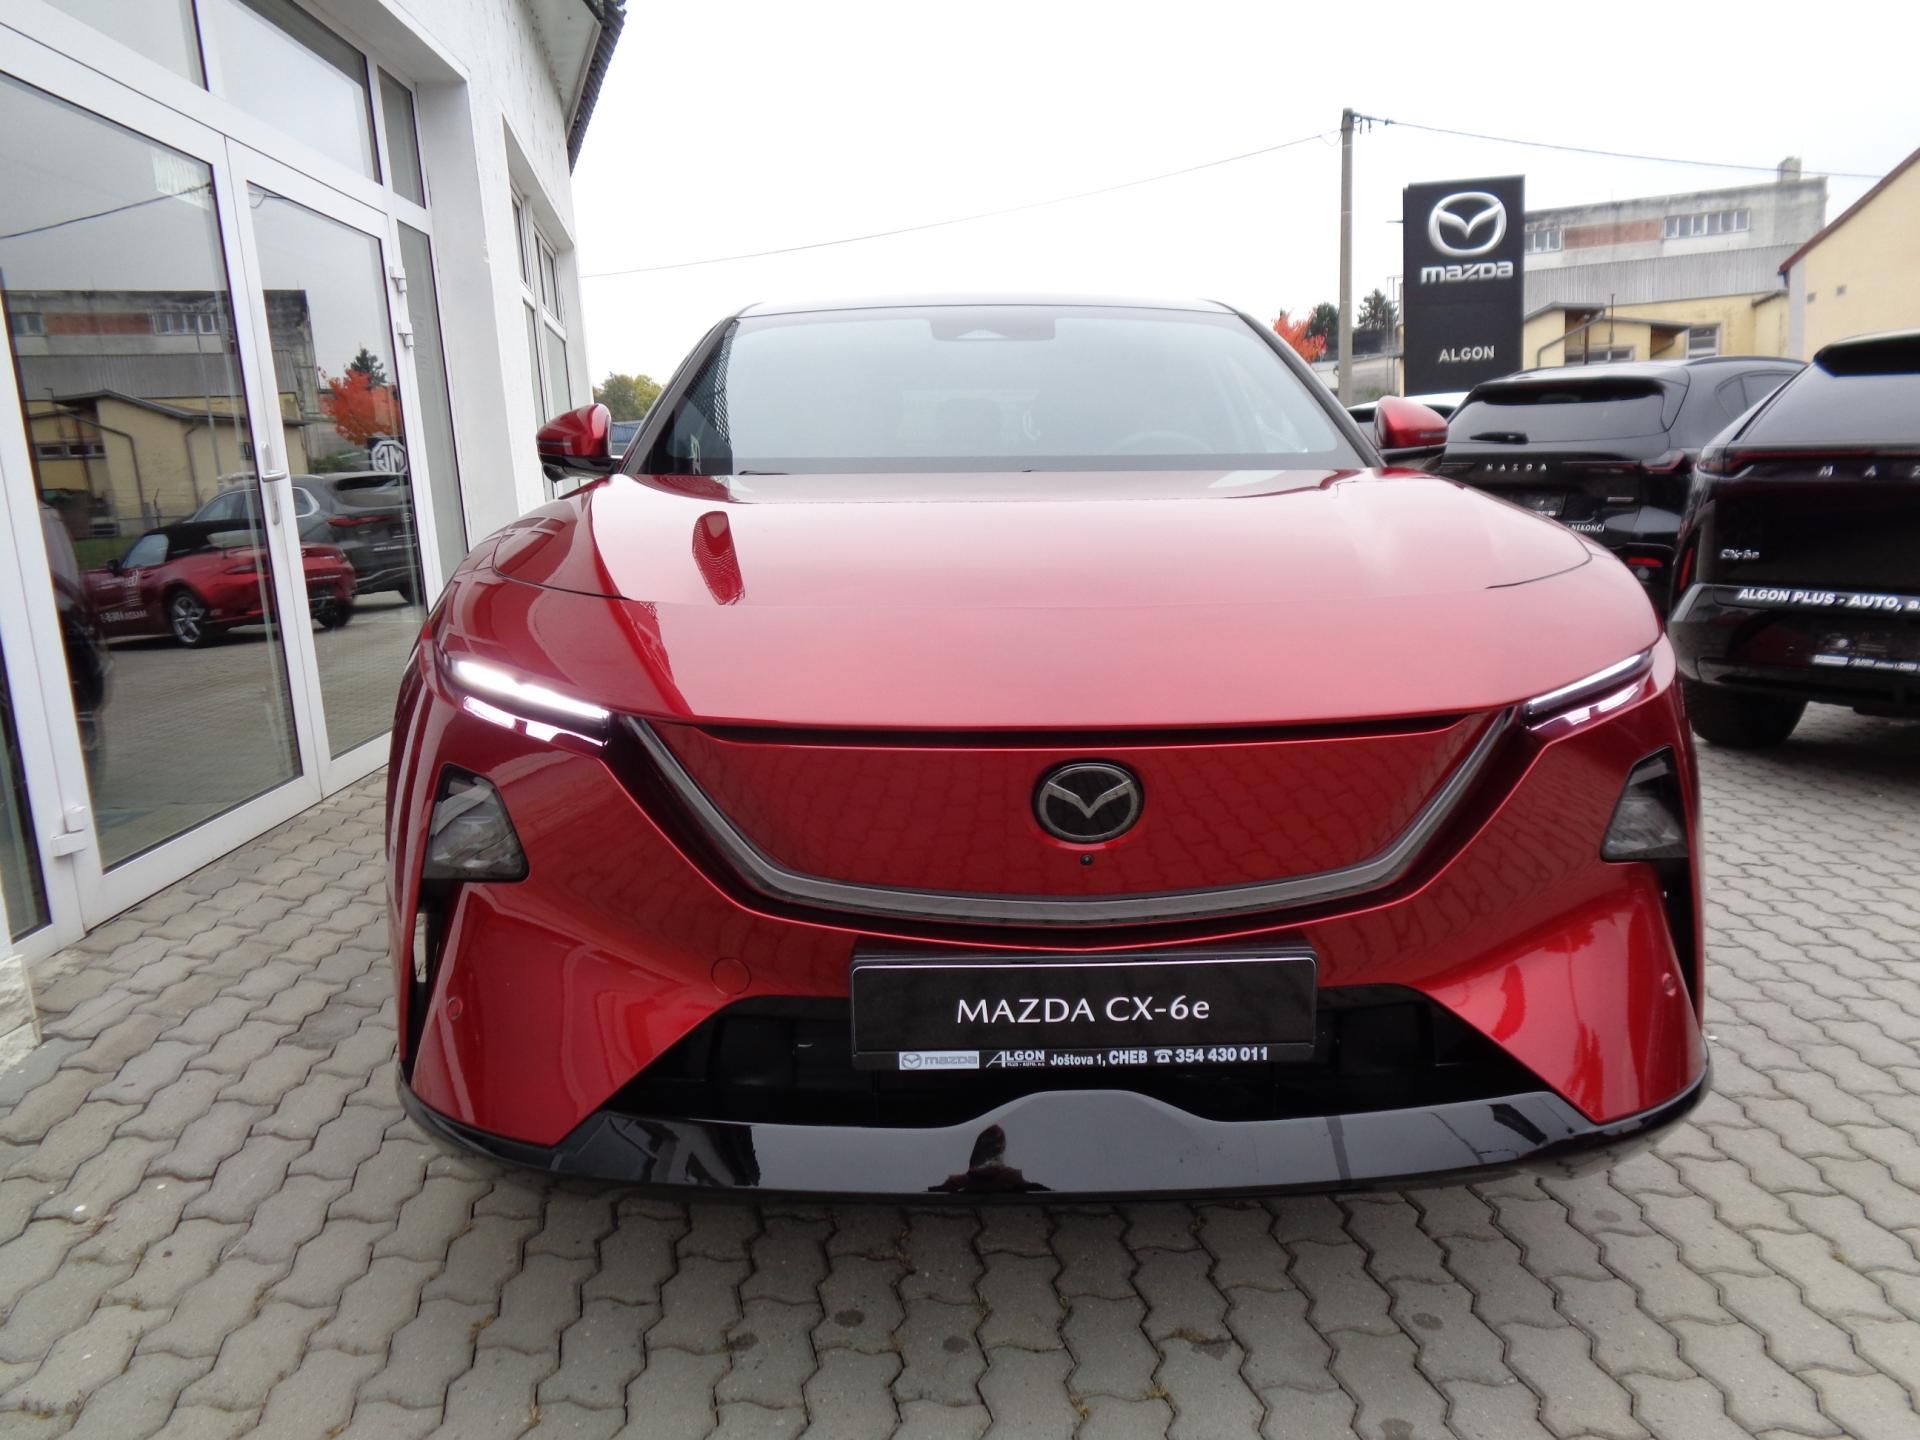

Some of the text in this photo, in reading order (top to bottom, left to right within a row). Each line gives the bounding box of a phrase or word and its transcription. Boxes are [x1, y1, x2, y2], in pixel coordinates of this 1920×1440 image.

[1421, 261, 1514, 283] mazda
[1439, 346, 1495, 362] ALGON
[1738, 588, 1790, 601] ALGON
[1793, 591, 1835, 604] PLUS
[1848, 594, 1902, 612] AUTO,
[957, 995, 1210, 1023] MAZDA CX-6e
[924, 1054, 978, 1066] mazda
[985, 1050, 1045, 1068] ALGON
[1050, 1054, 1093, 1066] Joštova
[1109, 1050, 1148, 1064] CHEB
[1175, 1049, 1204, 1063] 354
[1208, 1048, 1237, 1062] 430
[1240, 1047, 1269, 1061] 011
